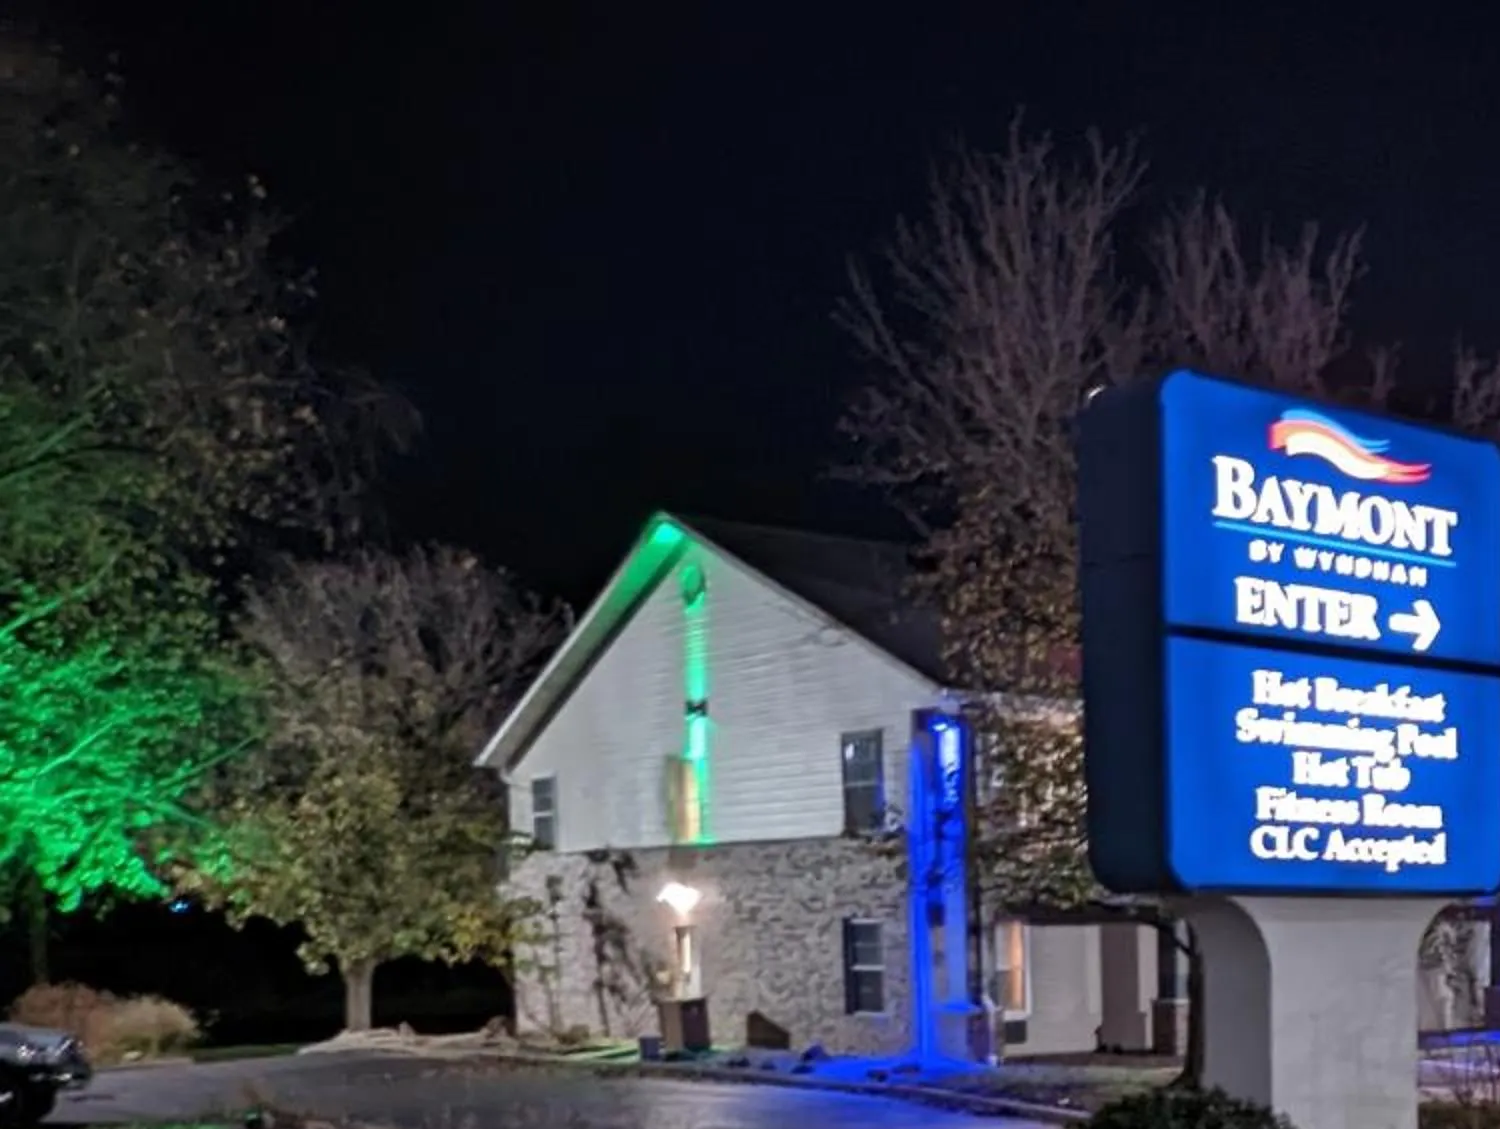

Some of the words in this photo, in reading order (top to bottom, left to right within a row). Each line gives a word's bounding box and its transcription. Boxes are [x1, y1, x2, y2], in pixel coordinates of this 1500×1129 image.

[1212, 456, 1458, 556] BAYMONT
[1249, 540, 1285, 563] BY
[1294, 548, 1427, 587] WYNDHAM
[1235, 576, 1381, 640] ENTER
[1351, 756, 1411, 791] Tub
[1250, 826, 1320, 860] CLC
[1322, 829, 1446, 872] Accepted
